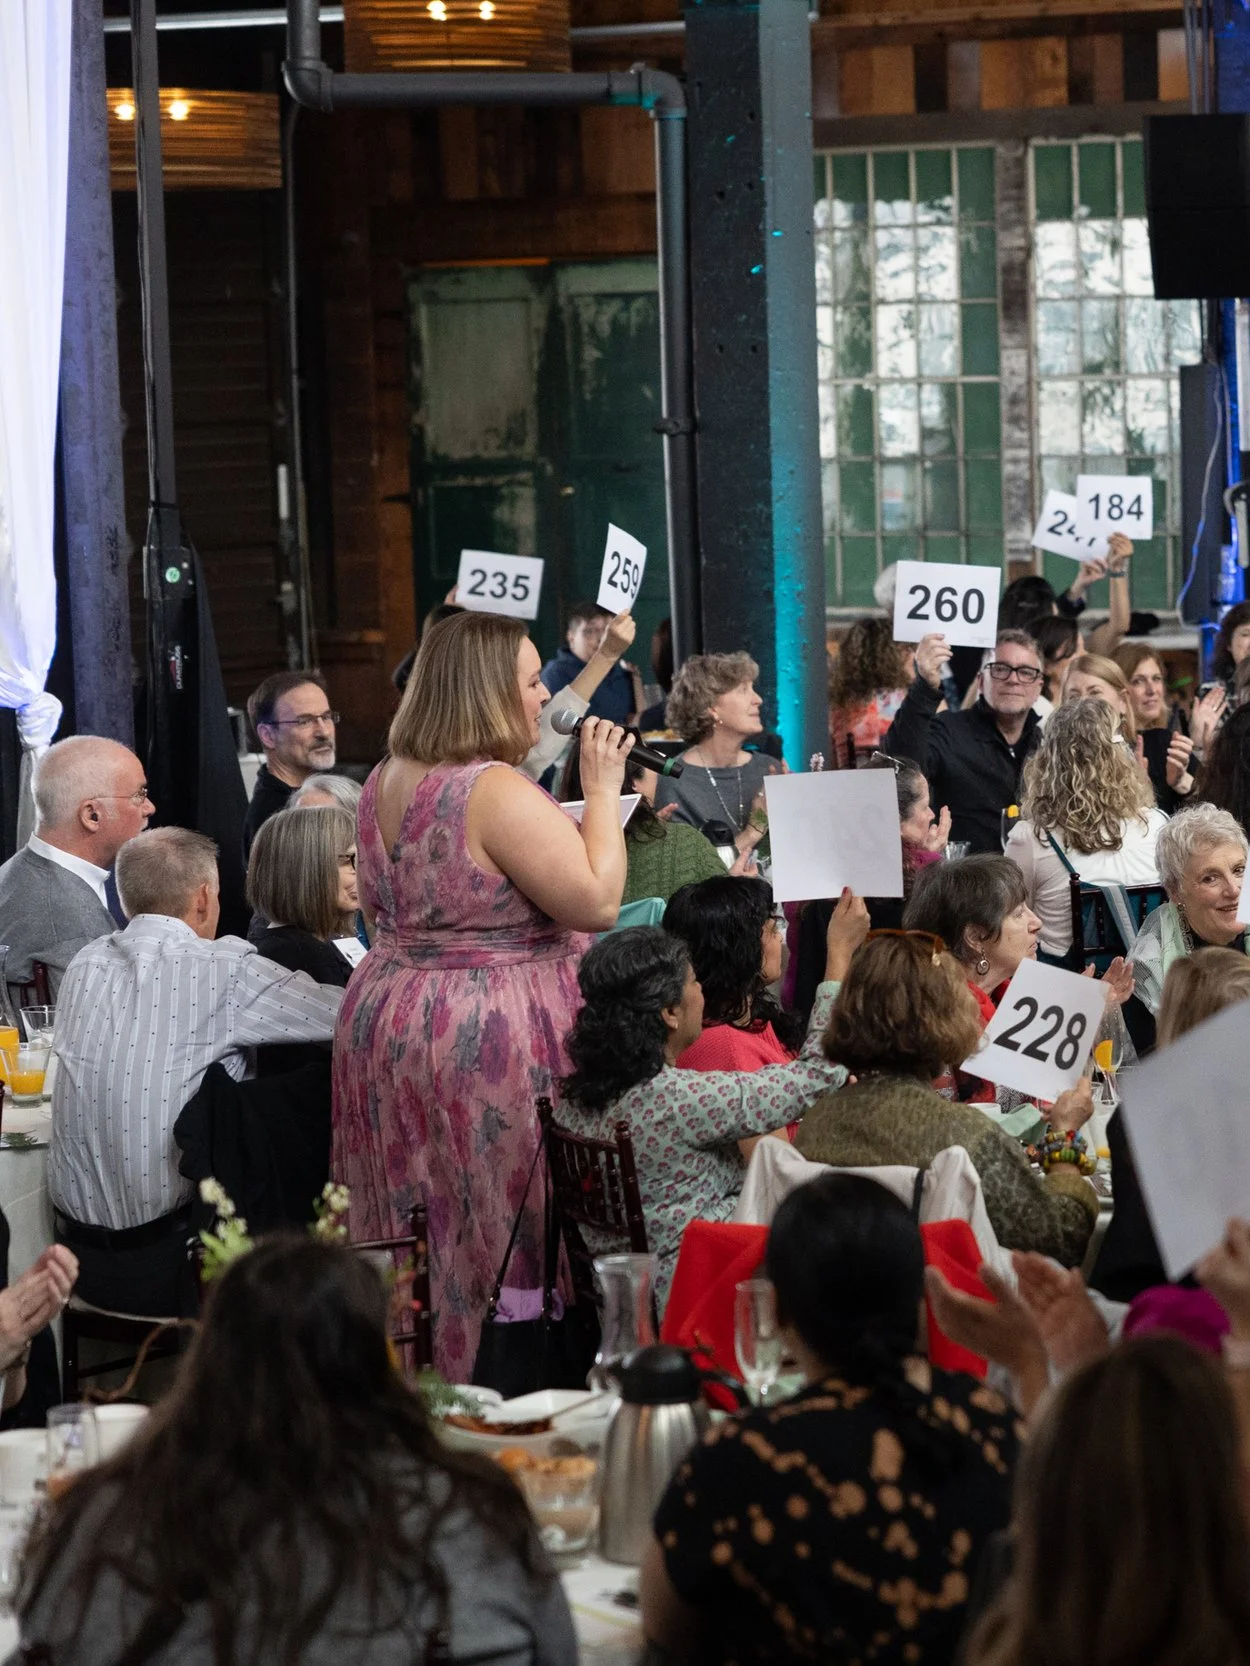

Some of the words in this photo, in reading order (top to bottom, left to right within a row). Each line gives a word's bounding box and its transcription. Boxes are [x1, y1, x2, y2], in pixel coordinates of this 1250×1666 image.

[1088, 493, 1144, 521] 184
[467, 568, 530, 602] 235
[607, 551, 640, 599] 259
[906, 584, 985, 624] 260
[993, 996, 1087, 1070] 228
